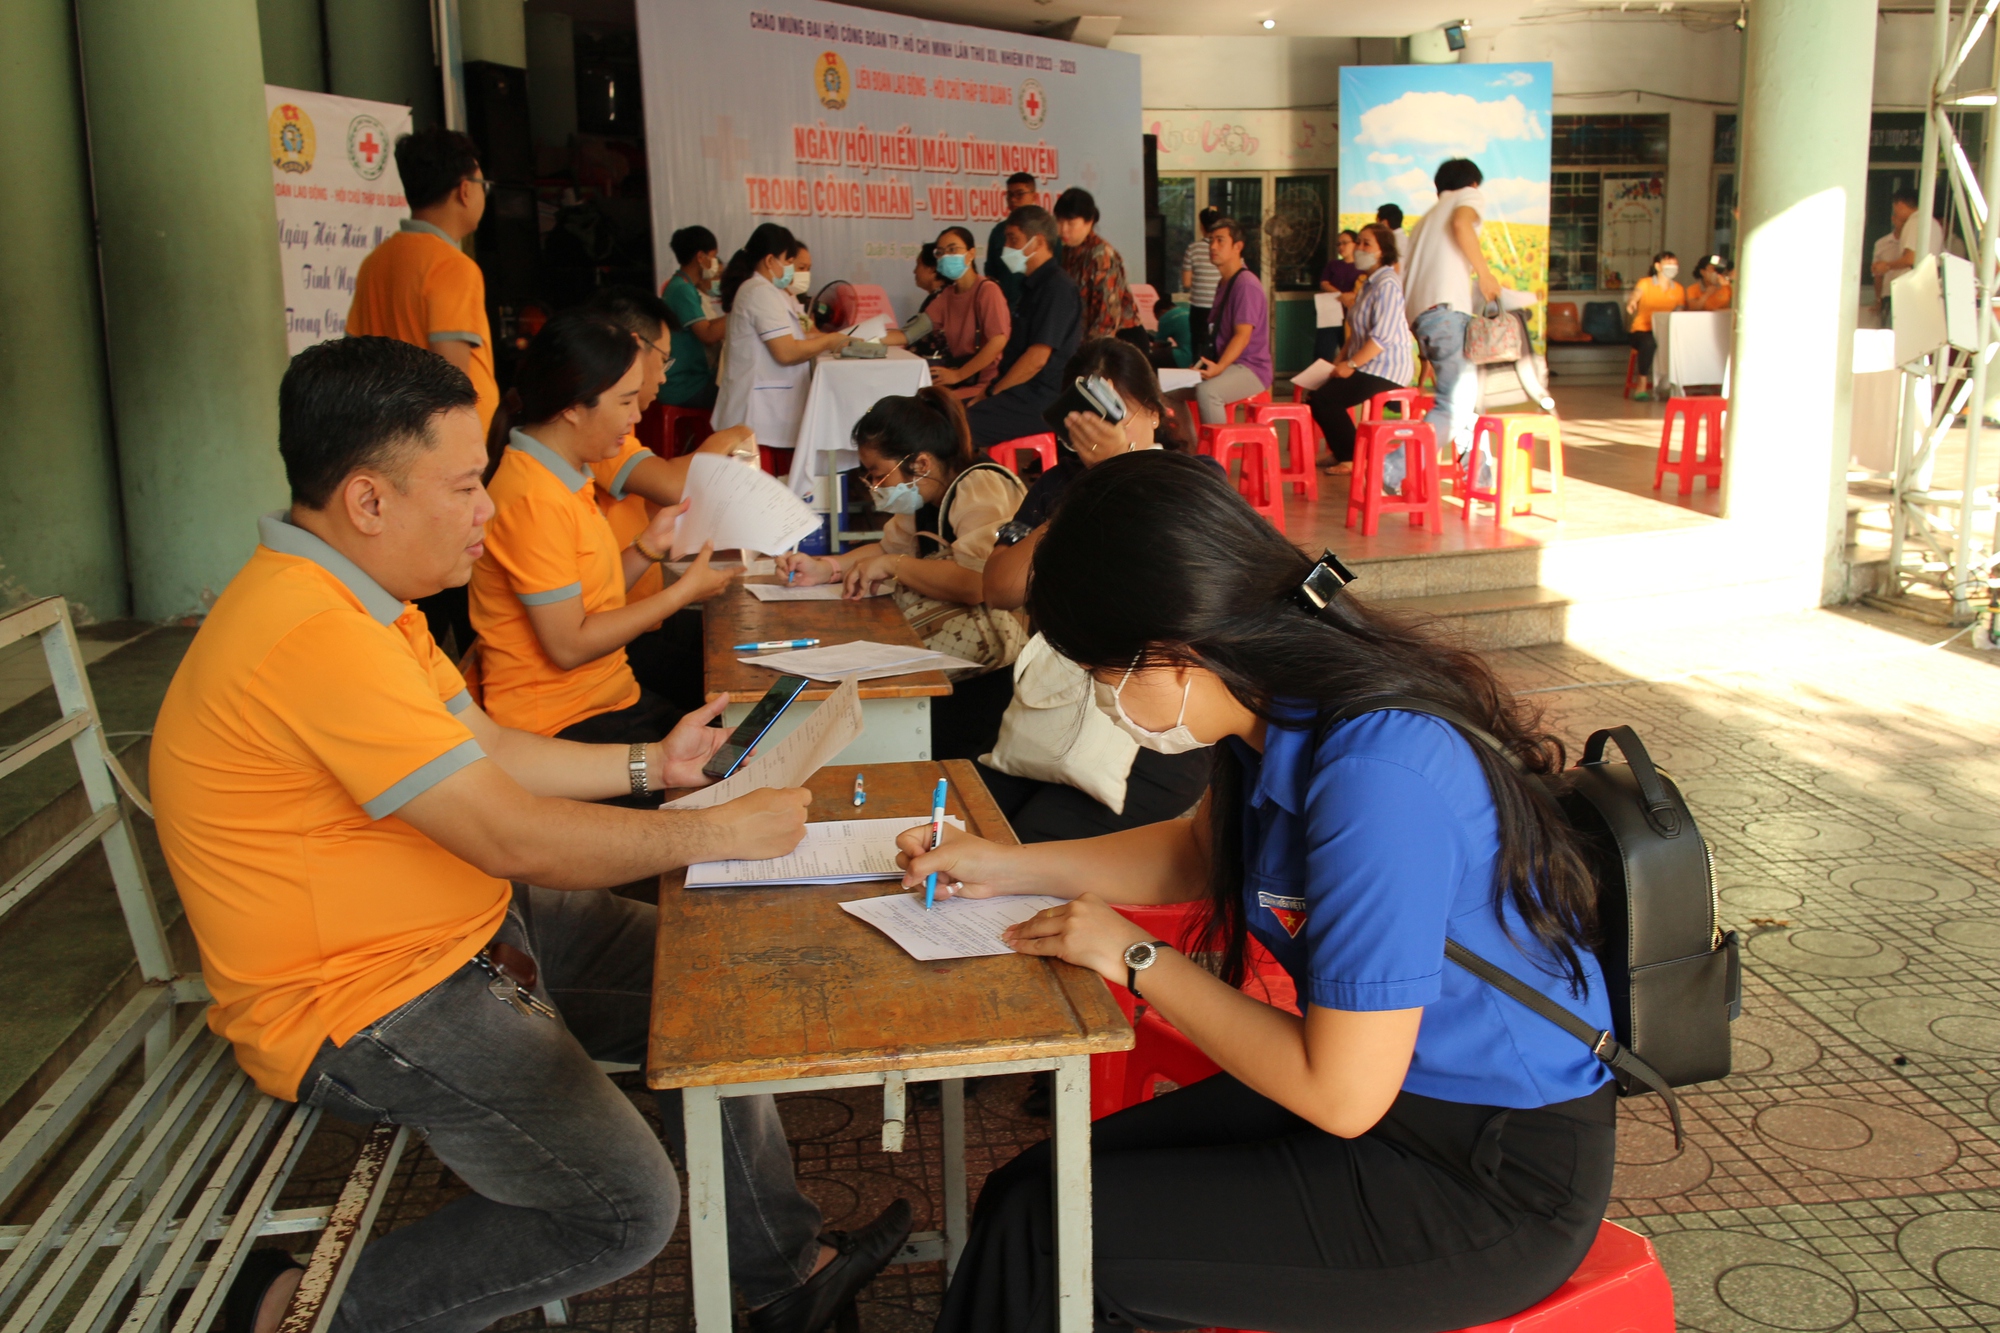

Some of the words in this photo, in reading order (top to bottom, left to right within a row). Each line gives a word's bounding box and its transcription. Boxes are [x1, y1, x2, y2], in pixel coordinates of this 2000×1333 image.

[794, 119, 842, 164] NGÀY
[846, 126, 876, 174] HỘI
[880, 126, 919, 169] HIẾN
[922, 133, 958, 172] MÁU
[961, 136, 998, 176] TÌNH
[1000, 138, 1058, 184] NGUYỆN
[746, 177, 809, 214] TRONG
[814, 174, 863, 215] CÔNG
[866, 175, 912, 217] NHÂN
[929, 181, 966, 219] VIÊN
[286, 308, 320, 338] Trong
[324, 308, 346, 334] Côn
